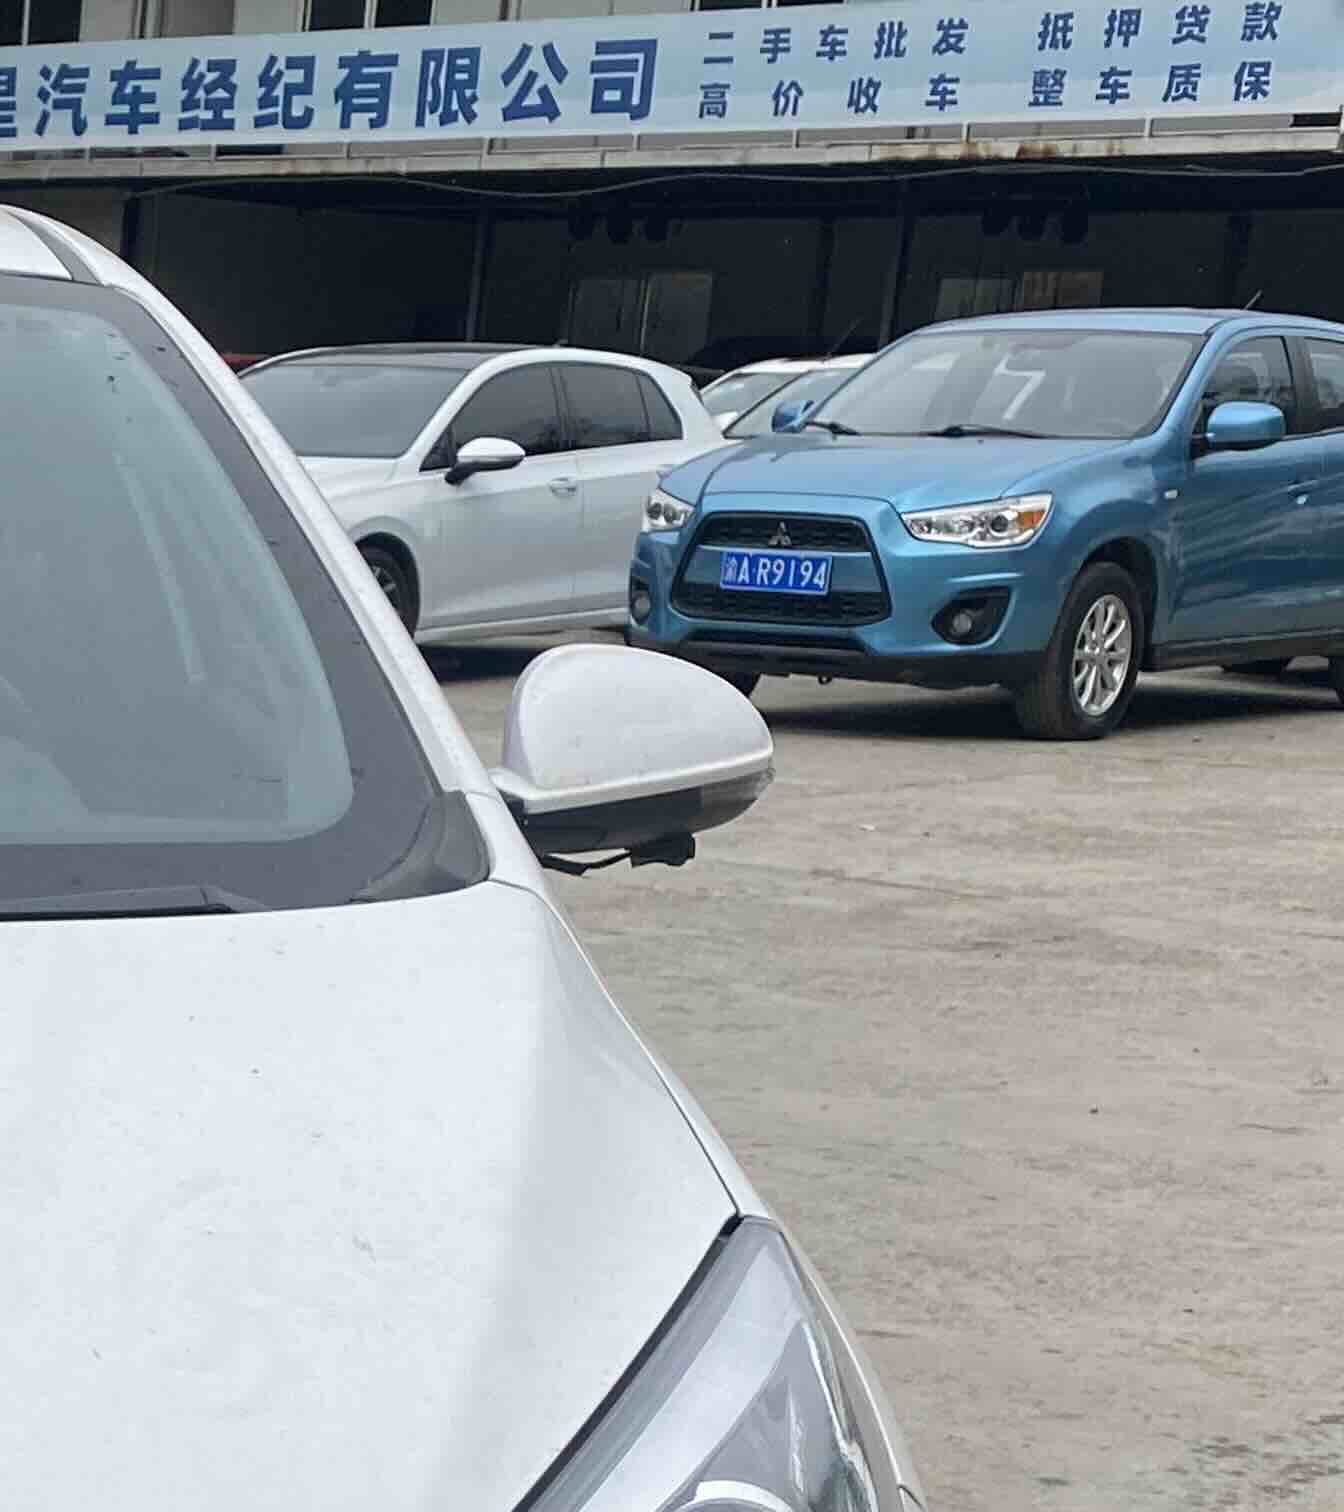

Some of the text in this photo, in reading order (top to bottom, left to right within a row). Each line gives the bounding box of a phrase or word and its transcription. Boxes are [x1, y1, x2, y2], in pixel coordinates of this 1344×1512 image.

[703, 2, 1283, 65] 二手车批发 抵押贷款
[698, 61, 1272, 119] 高价收车 整车质保
